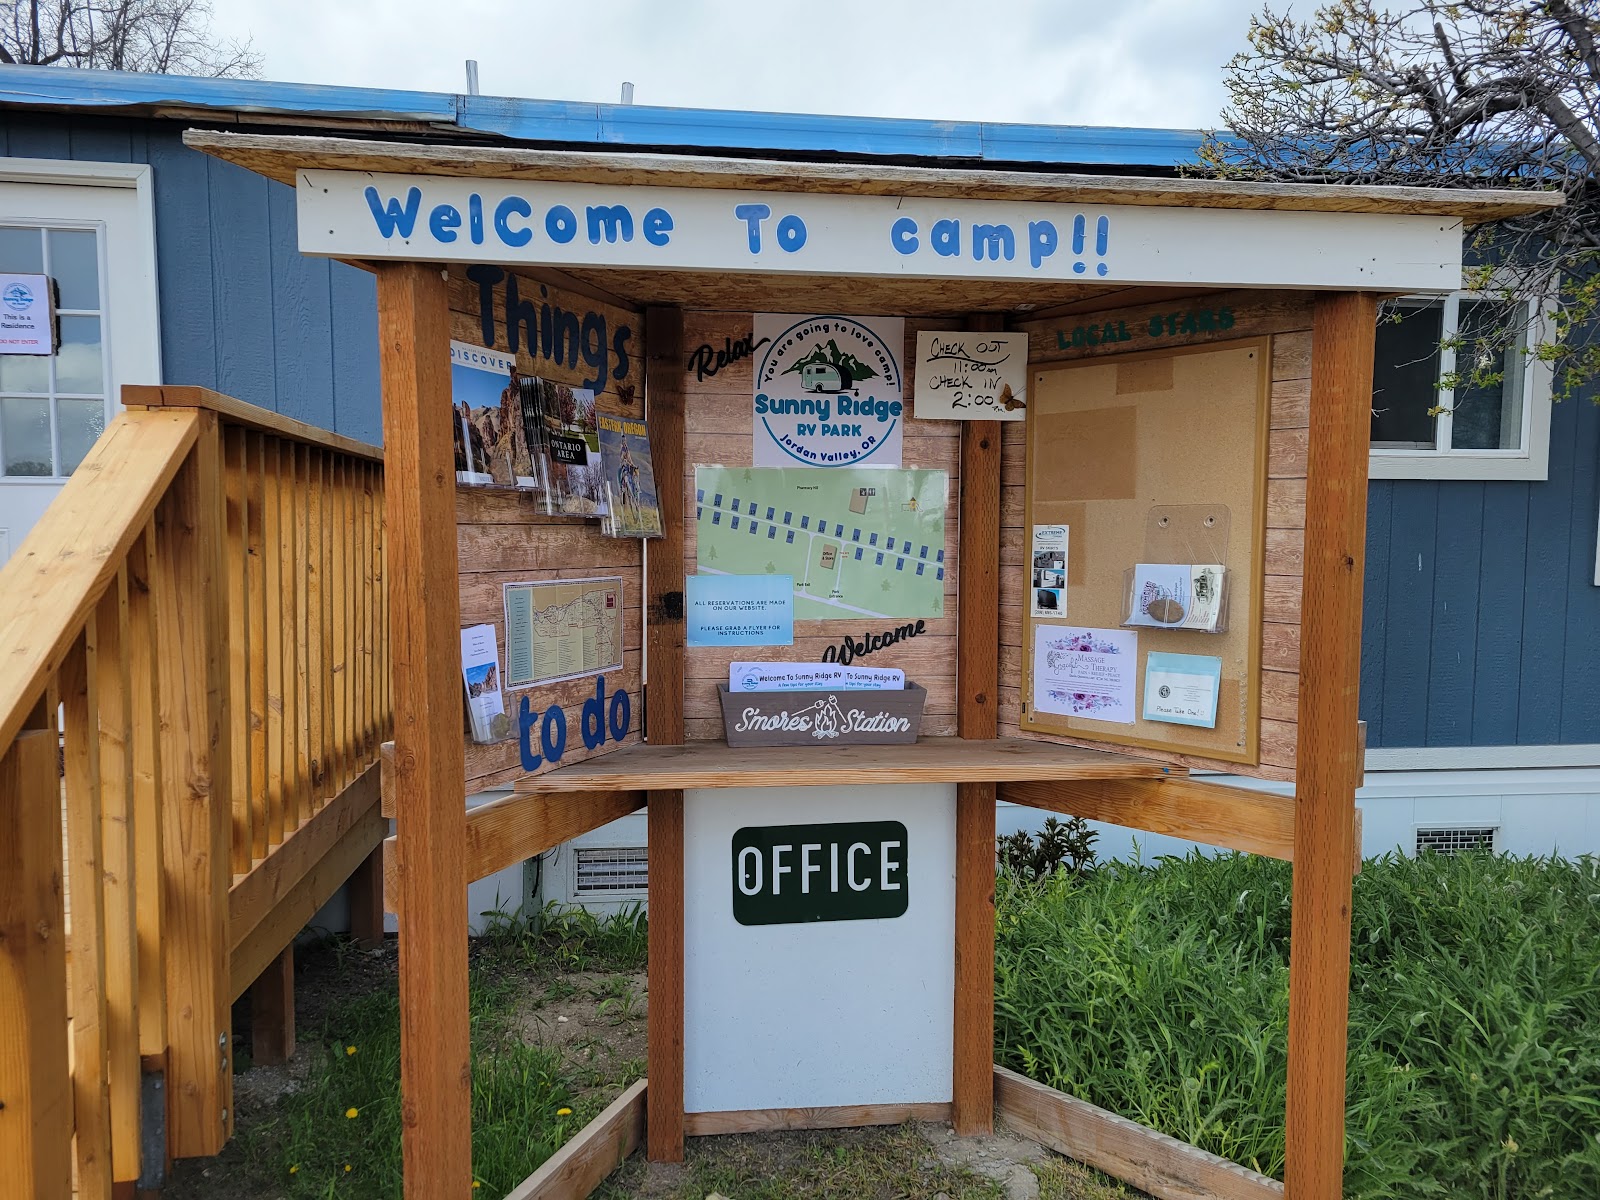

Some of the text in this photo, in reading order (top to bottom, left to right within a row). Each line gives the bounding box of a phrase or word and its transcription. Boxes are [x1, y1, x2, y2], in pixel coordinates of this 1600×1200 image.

[734, 202, 808, 256] To
[890, 213, 1111, 278] camp!!
[466, 264, 632, 396] Things
[1056, 306, 1236, 350] LOCAL STARS
[450, 347, 513, 370] DISCOVER
[687, 333, 771, 383] Relax
[764, 322, 896, 386] You are going to love camp!
[930, 337, 1009, 358] CHECK OUT
[929, 375, 1002, 390] CHECK IN
[755, 393, 903, 422] Sunny Ridge
[797, 423, 862, 437] RV PARK
[551, 440, 581, 451] ONTARIO
[557, 450, 575, 460] AREA
[779, 433, 817, 460] Jordan
[861, 435, 876, 450] OR
[822, 619, 926, 666] Welcome
[795, 673, 814, 682] Sunny
[814, 672, 833, 681] Ridge
[854, 672, 873, 682] Sunny
[873, 673, 891, 682] Ridge
[841, 708, 911, 733] Station
[1156, 705, 1172, 713] Please
[1174, 706, 1185, 714] Take
[519, 675, 631, 772] to do
[738, 841, 901, 896] OFFICE
